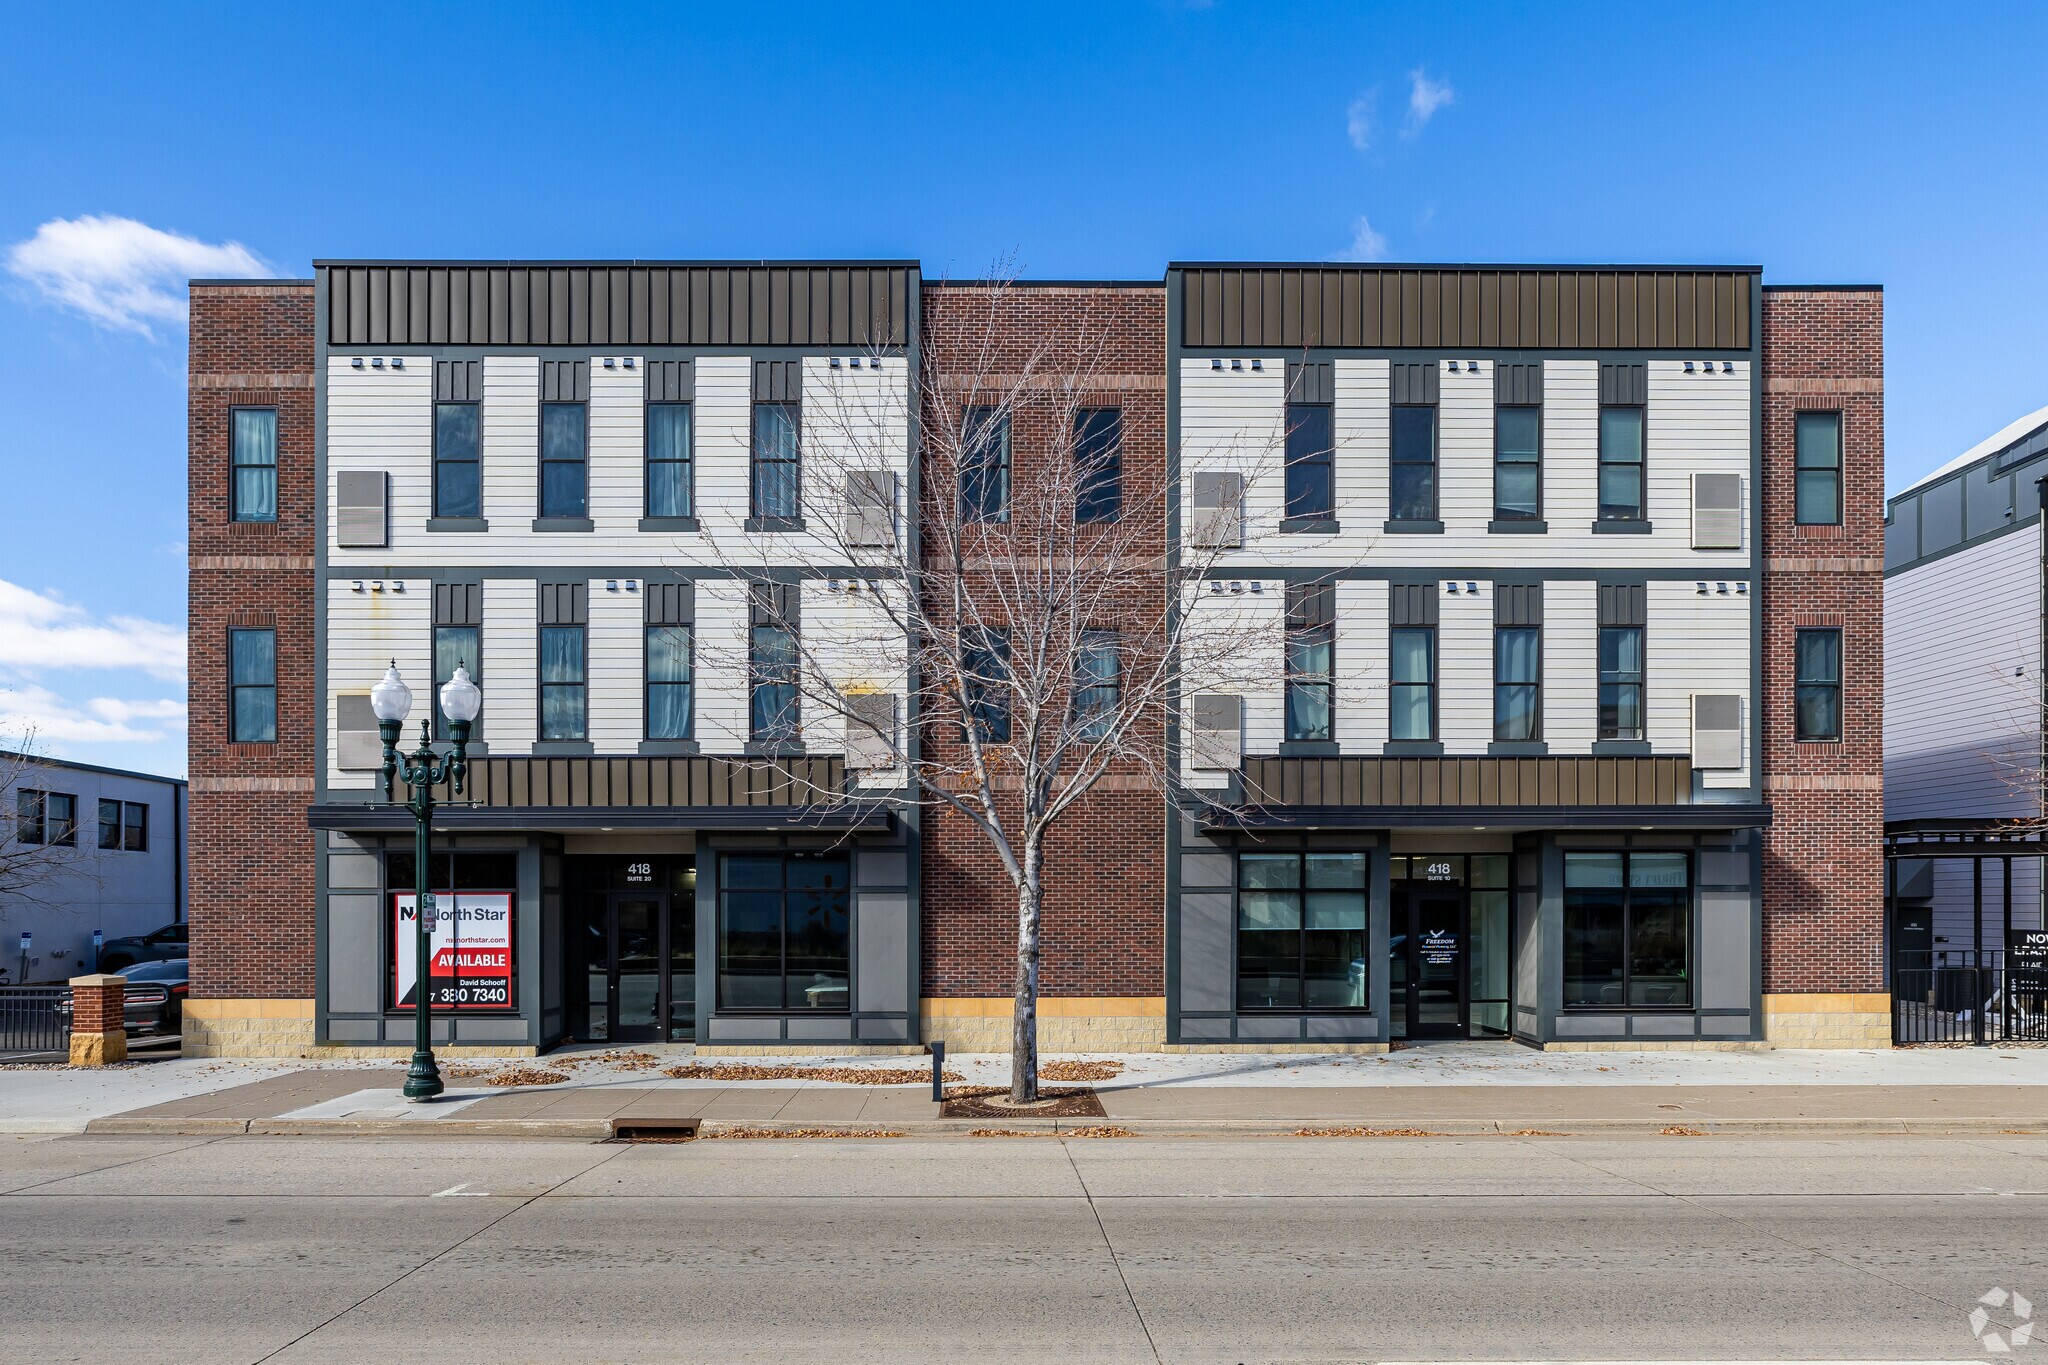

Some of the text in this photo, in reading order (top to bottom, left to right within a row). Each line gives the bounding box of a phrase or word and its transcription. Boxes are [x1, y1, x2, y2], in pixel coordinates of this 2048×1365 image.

[628, 863, 651, 874] 418
[1428, 863, 1451, 874] 418
[474, 908, 506, 921] Star
[2026, 934, 2048, 944] NO
[2014, 945, 2048, 956] LEAS
[438, 954, 506, 966] AVAILABLE
[441, 988, 468, 1002] 380
[472, 988, 506, 1002] 7340
